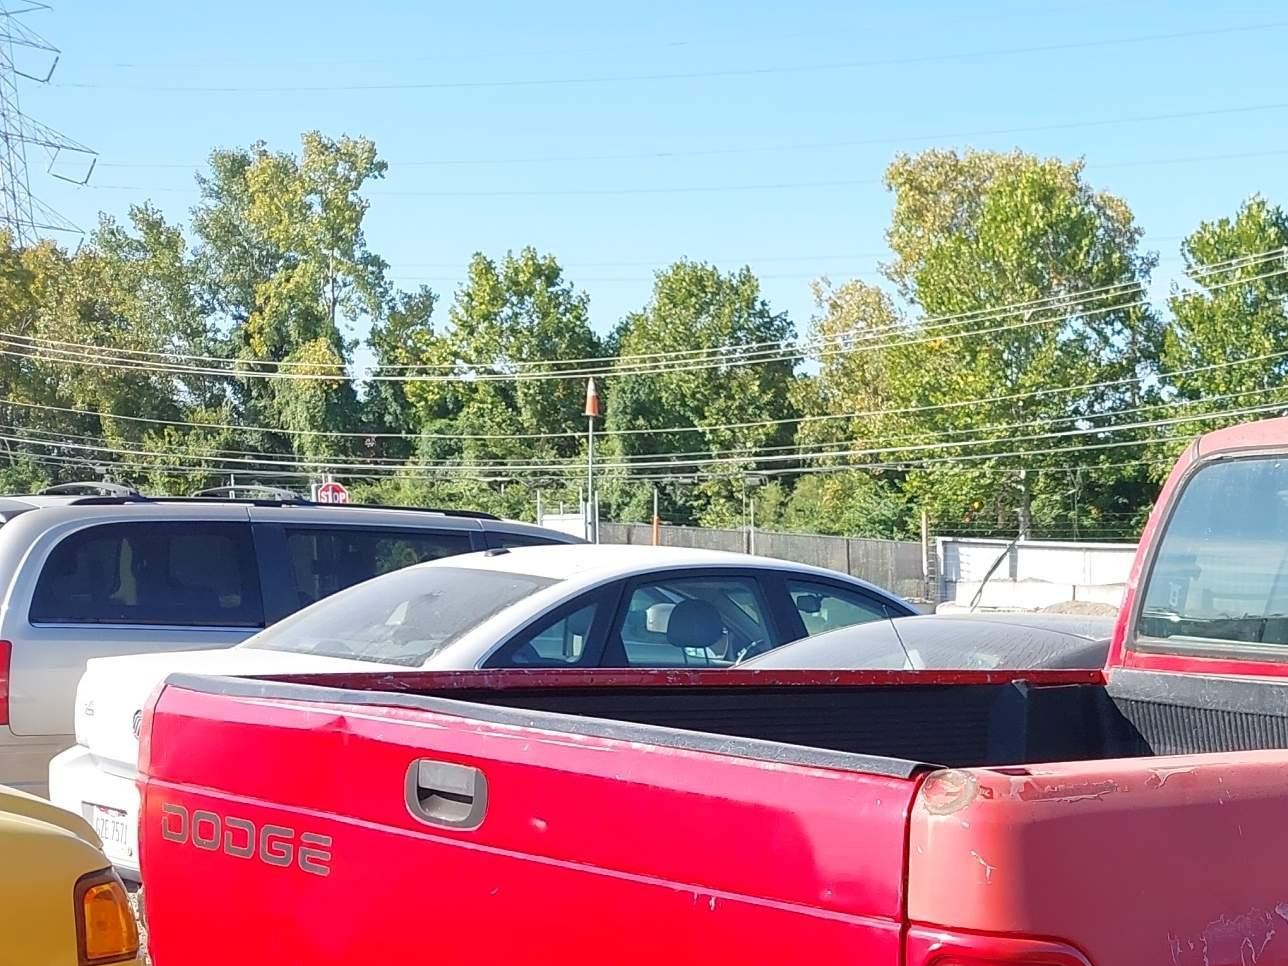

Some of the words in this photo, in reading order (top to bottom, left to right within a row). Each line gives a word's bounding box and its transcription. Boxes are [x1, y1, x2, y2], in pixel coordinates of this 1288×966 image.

[320, 490, 346, 503] STOP
[111, 819, 128, 845] 7571
[161, 802, 333, 877] DODGE
